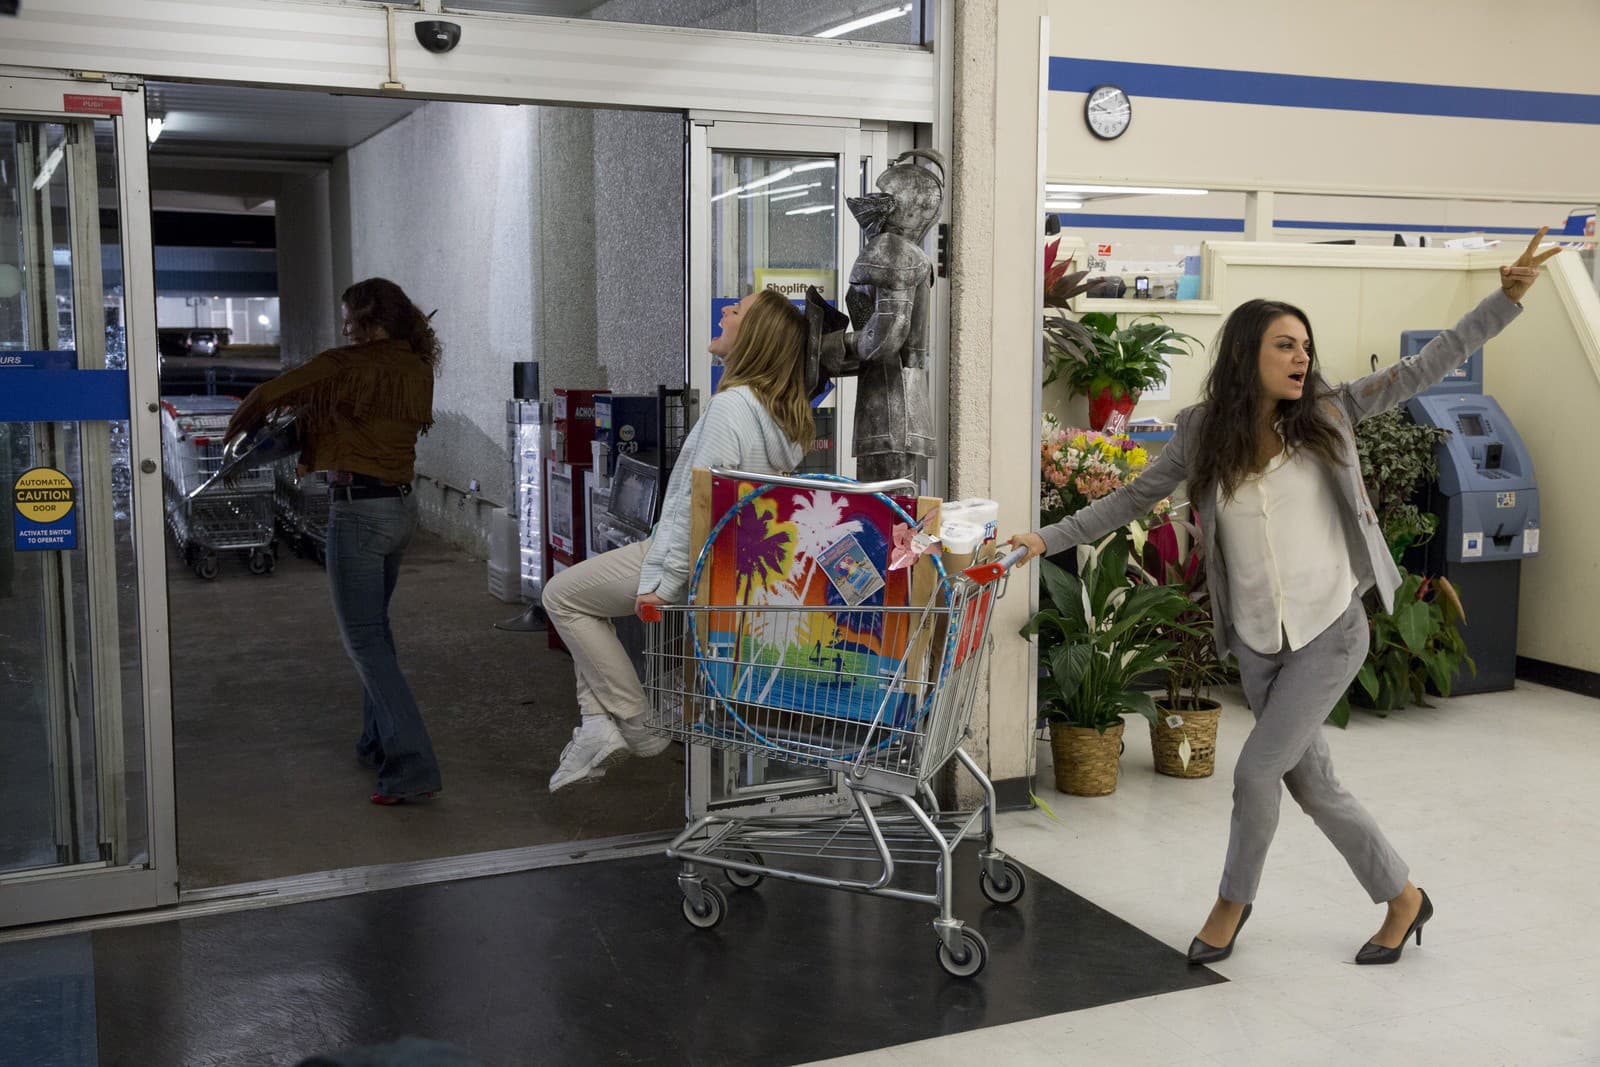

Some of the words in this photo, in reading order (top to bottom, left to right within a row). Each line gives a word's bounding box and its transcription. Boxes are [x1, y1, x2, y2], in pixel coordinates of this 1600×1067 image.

[766, 282, 825, 295] Shopliftrs
[20, 479, 66, 487] AUTOMATIC
[16, 490, 71, 501] CAUTION
[33, 504, 57, 512] DOOR
